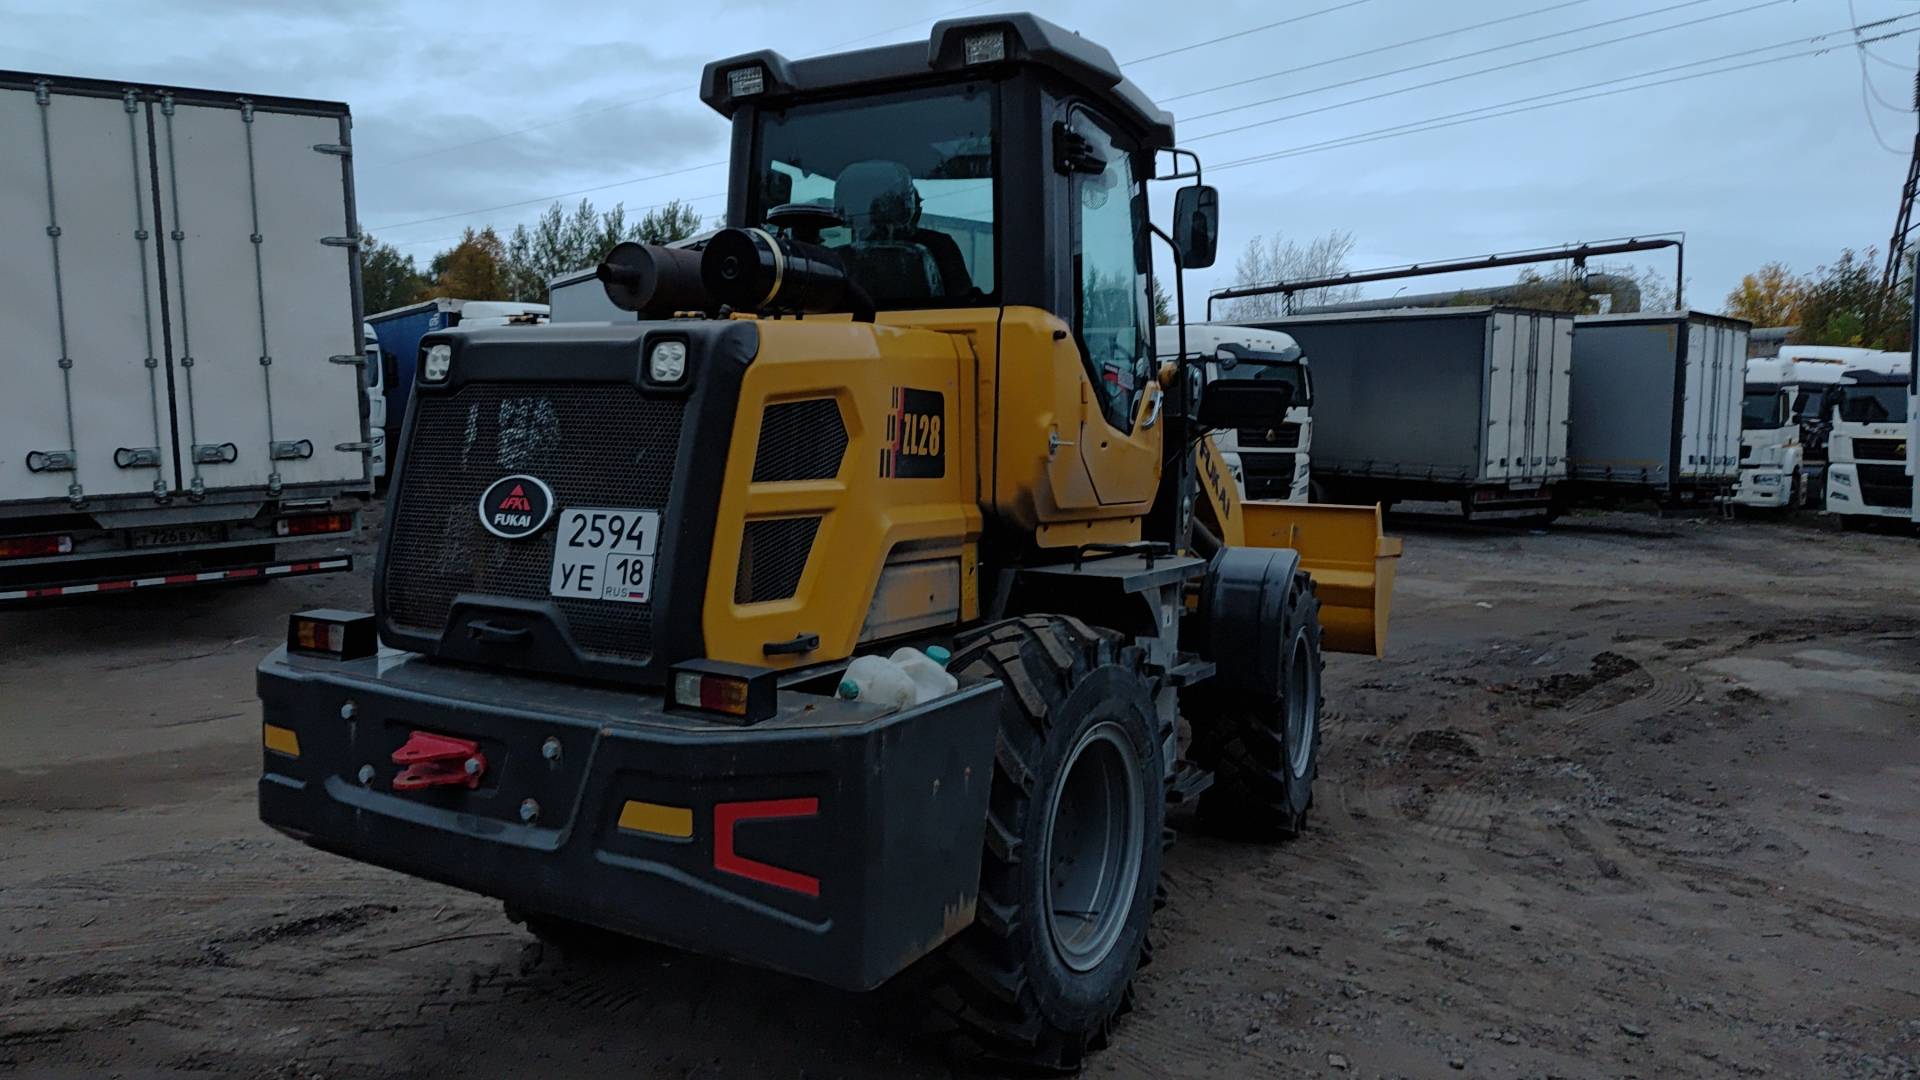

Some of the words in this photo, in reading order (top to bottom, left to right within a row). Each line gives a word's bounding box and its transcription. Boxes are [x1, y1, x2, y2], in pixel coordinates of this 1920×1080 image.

[902, 413, 941, 457] ZL28
[1200, 439, 1231, 521] FUKAI
[494, 513, 532, 527] FUKAI
[568, 513, 644, 551] 2594
[616, 559, 644, 586] 18
[605, 586, 628, 598] RUS
